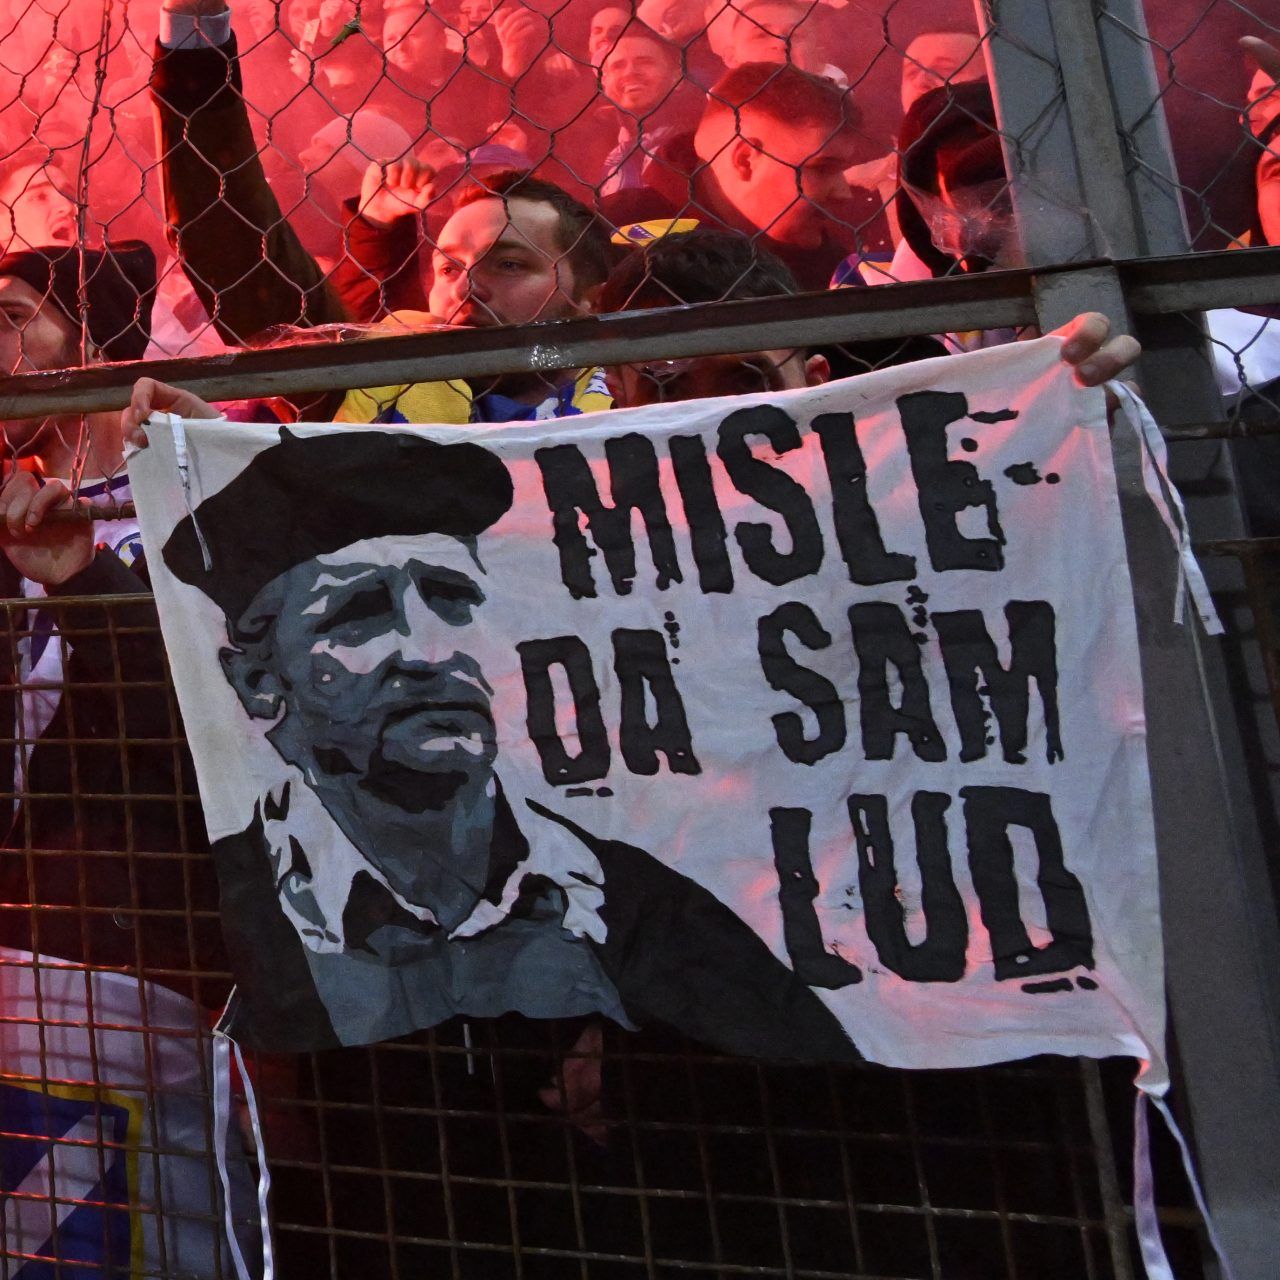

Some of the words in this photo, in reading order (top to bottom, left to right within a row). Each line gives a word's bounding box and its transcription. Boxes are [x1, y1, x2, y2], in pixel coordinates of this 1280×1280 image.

[533, 392, 1007, 600] MISLE
[515, 628, 703, 788] DA
[757, 600, 1065, 767] SAM
[767, 786, 1097, 988] LUD
